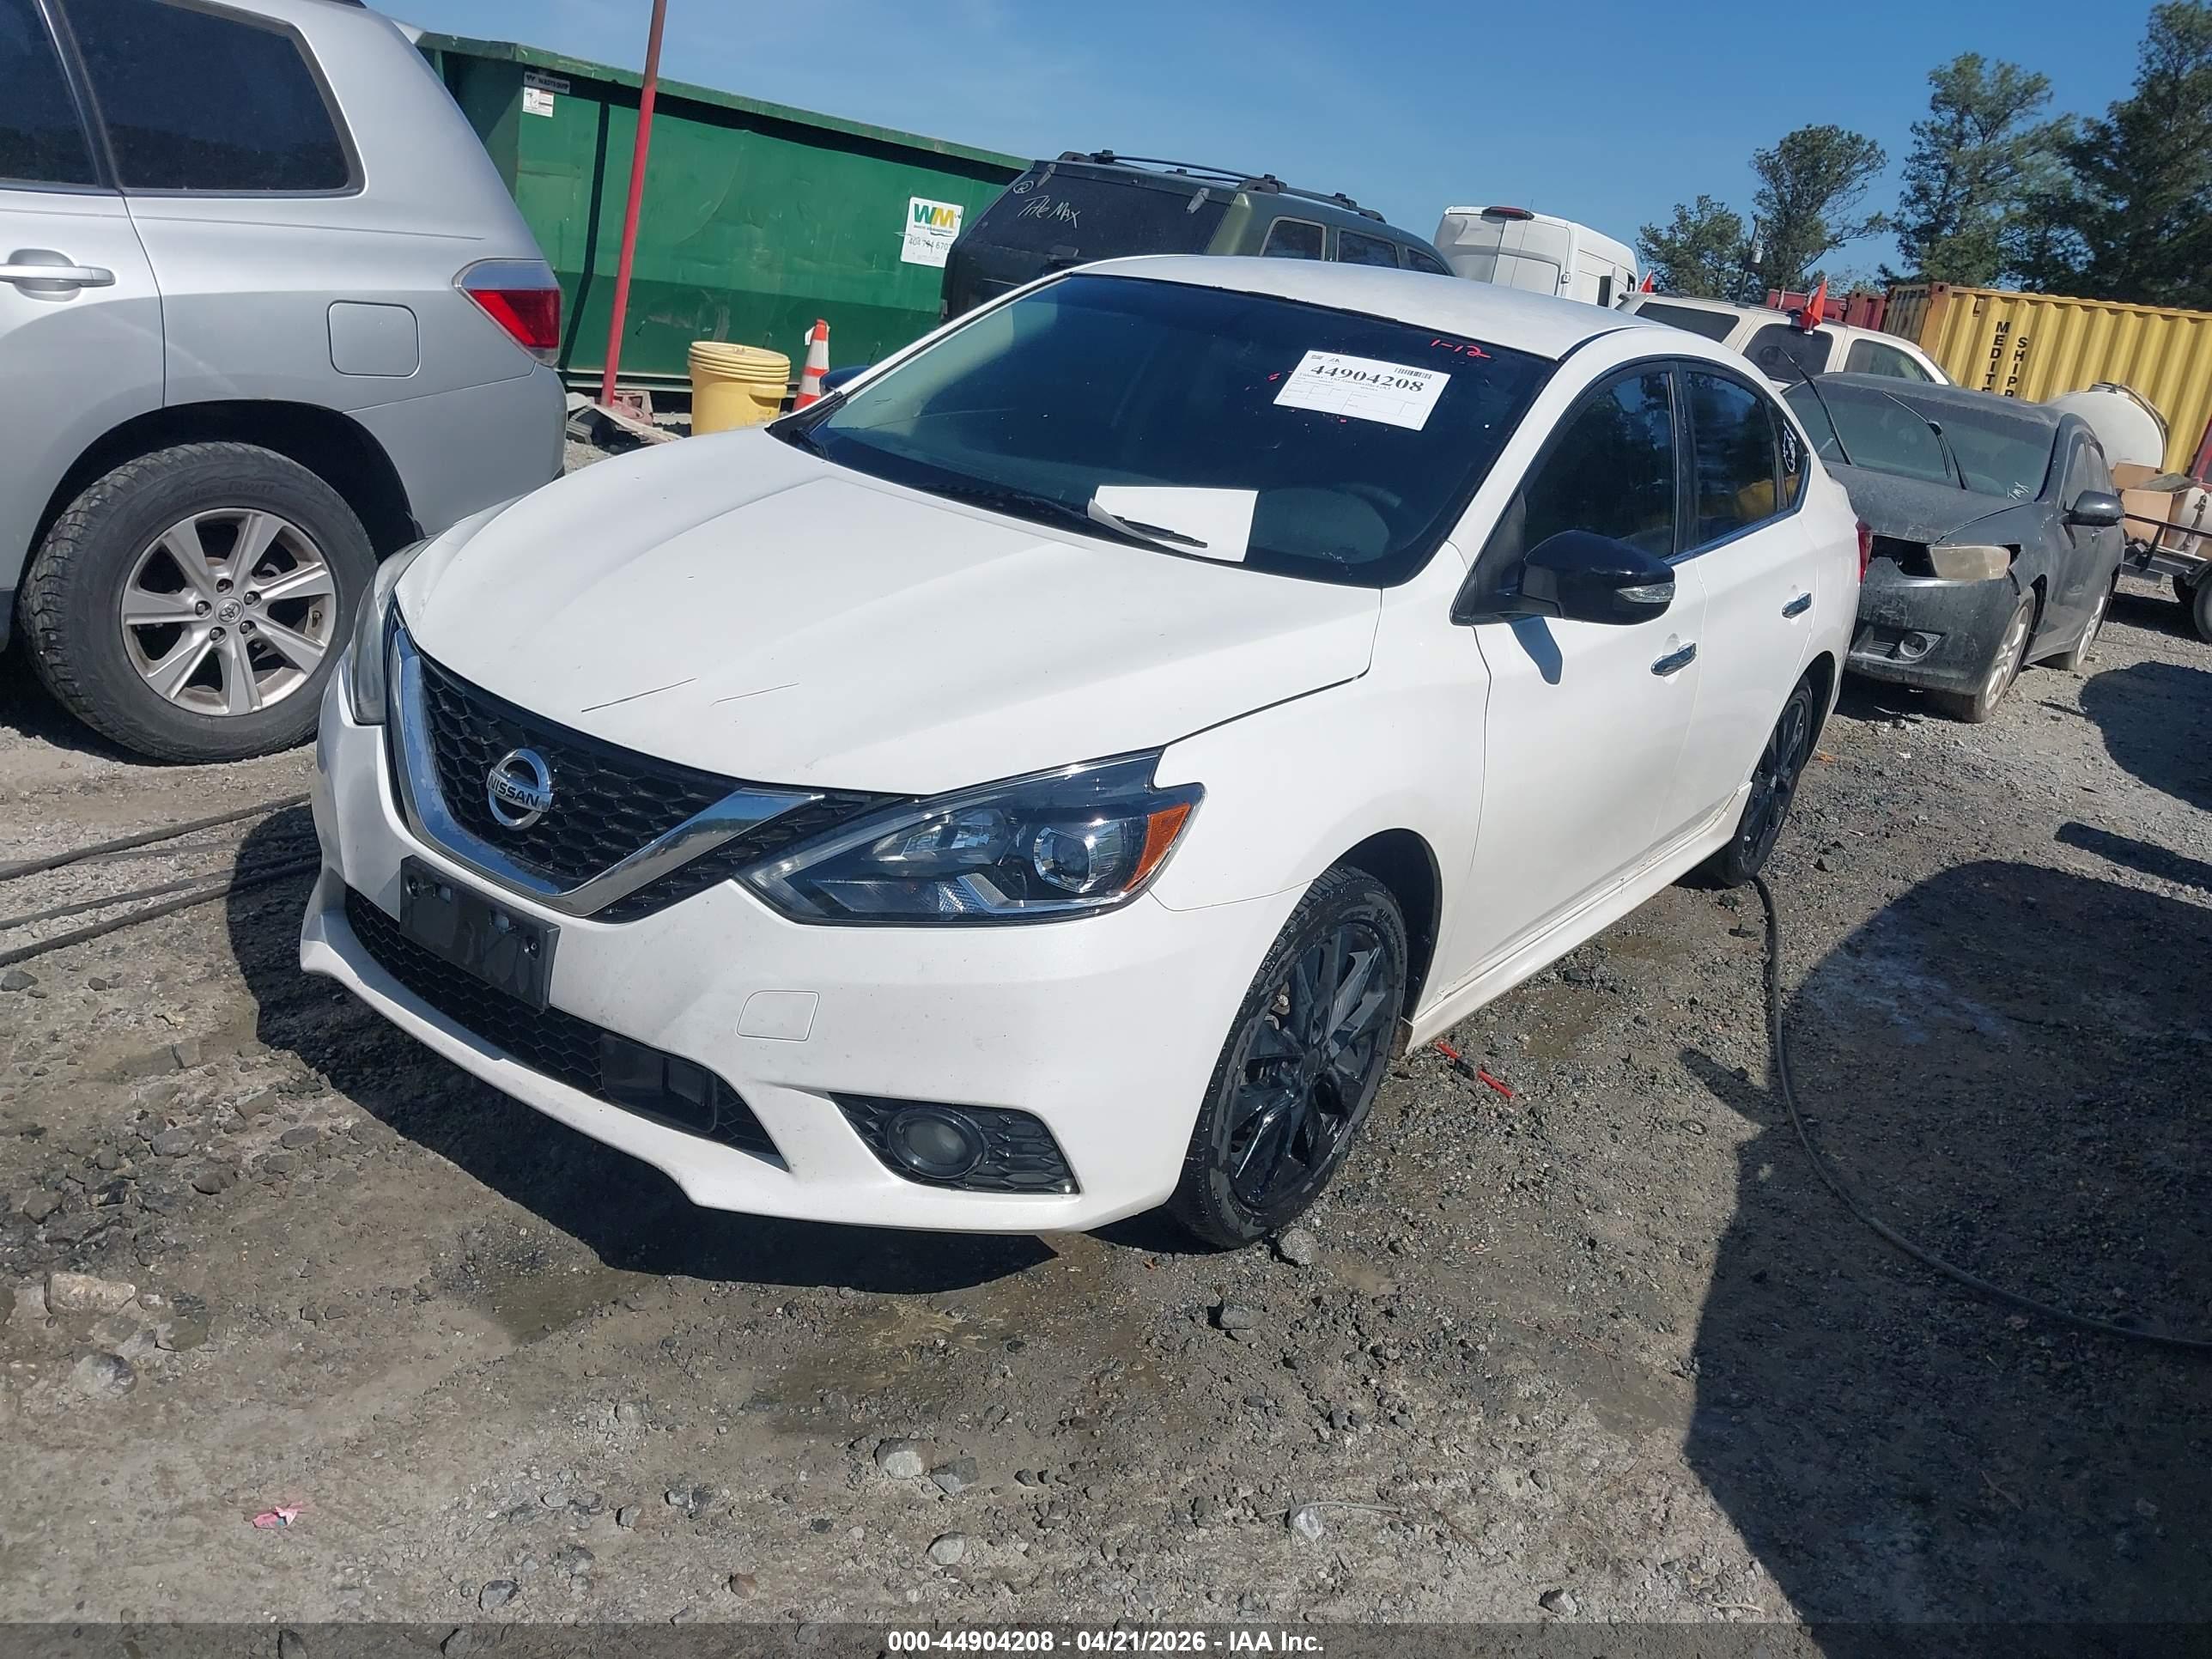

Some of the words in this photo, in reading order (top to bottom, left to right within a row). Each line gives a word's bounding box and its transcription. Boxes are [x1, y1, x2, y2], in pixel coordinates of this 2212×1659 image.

[914, 203, 955, 228] WM
[1430, 339, 1492, 359] 1-12
[1310, 365, 1425, 392] 44904208
[488, 775, 540, 807] NISSAN
